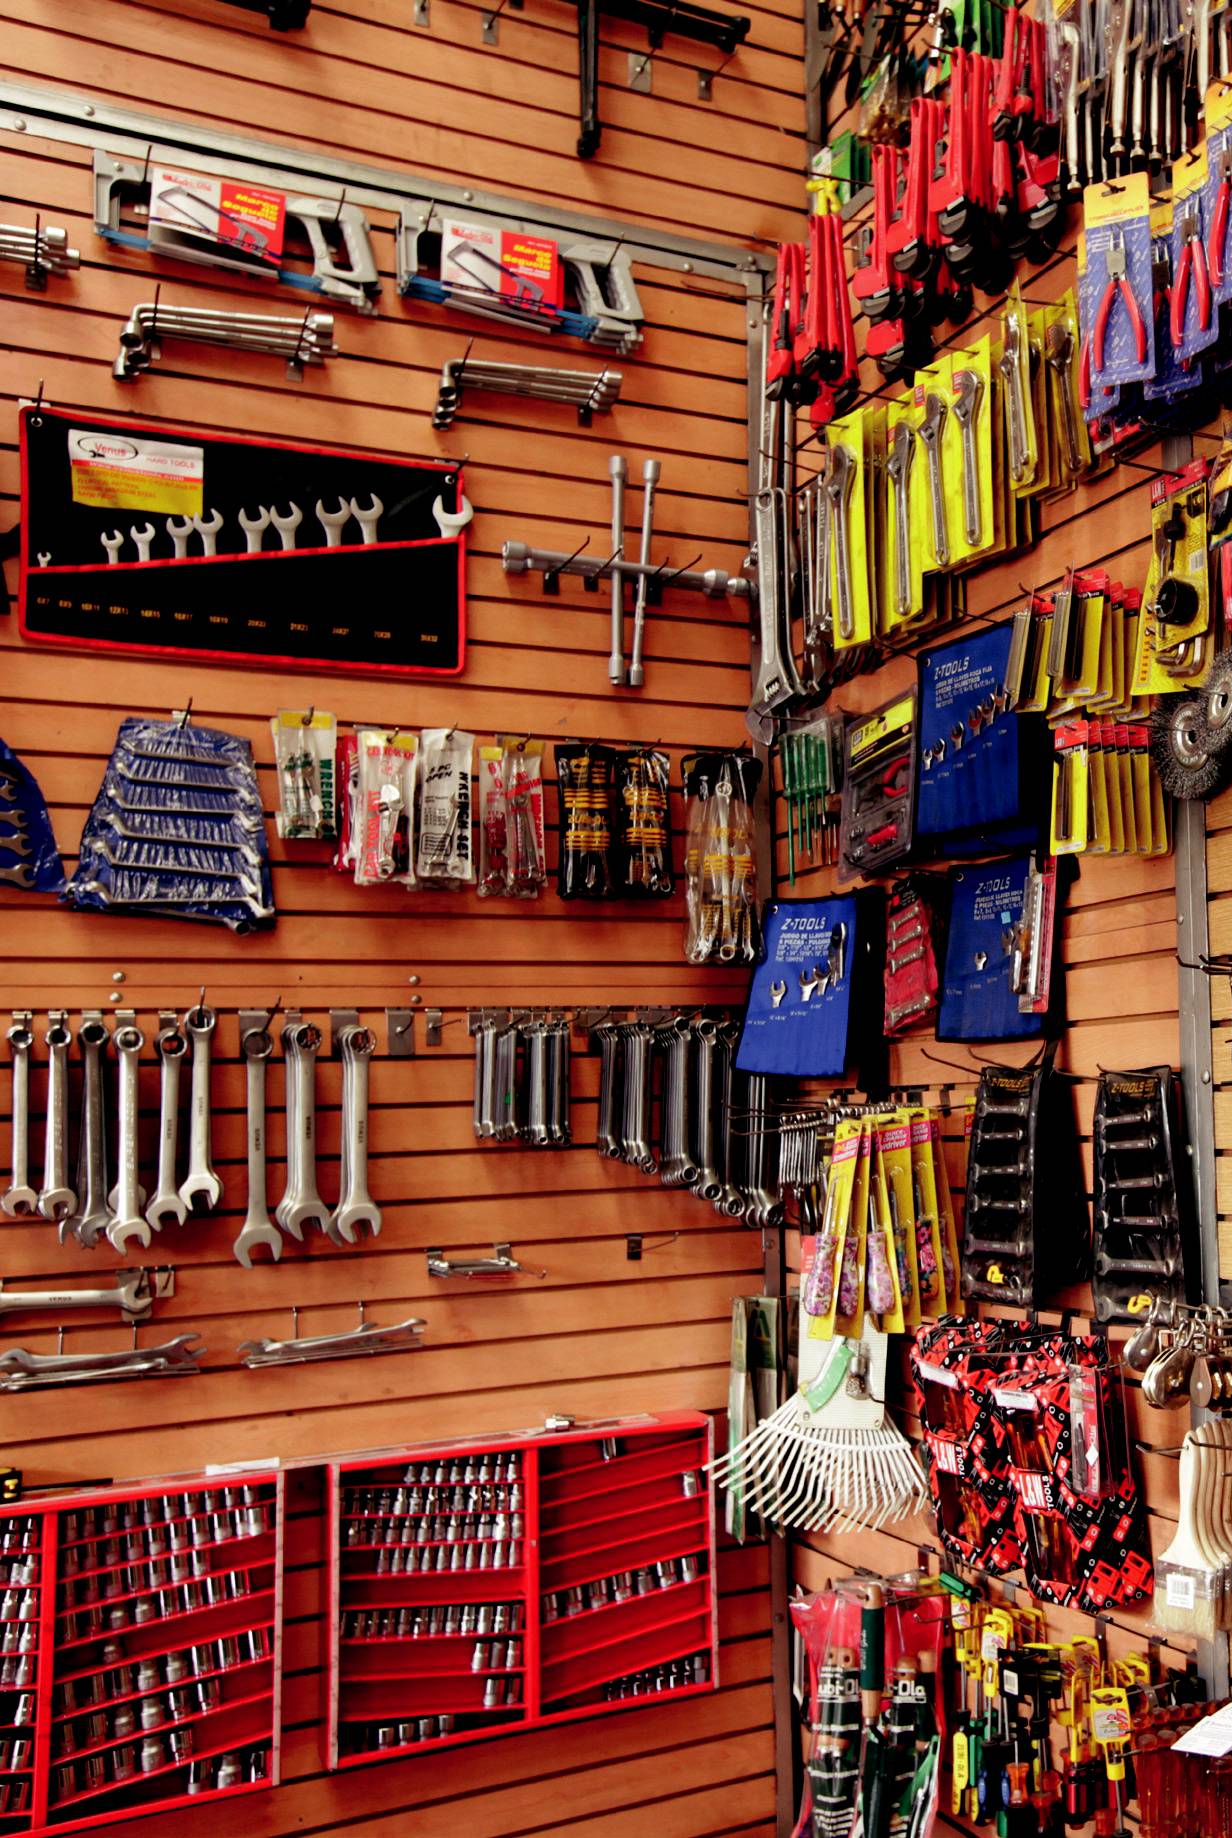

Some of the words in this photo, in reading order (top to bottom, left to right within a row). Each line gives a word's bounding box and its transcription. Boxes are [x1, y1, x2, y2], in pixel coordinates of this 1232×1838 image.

[934, 656, 970, 680] Z-TOOLS
[319, 759, 333, 819] WRENCH
[457, 771, 469, 829] WRENCH
[456, 834, 469, 860] SET
[781, 917, 826, 930] Z-TOOLS
[1111, 1081, 1145, 1094] Z-TOOLS
[955, 1446, 965, 1476] TOOLS
[1042, 1475, 1054, 1509] TOOLS
[818, 1678, 859, 1696] ubi-Ol
